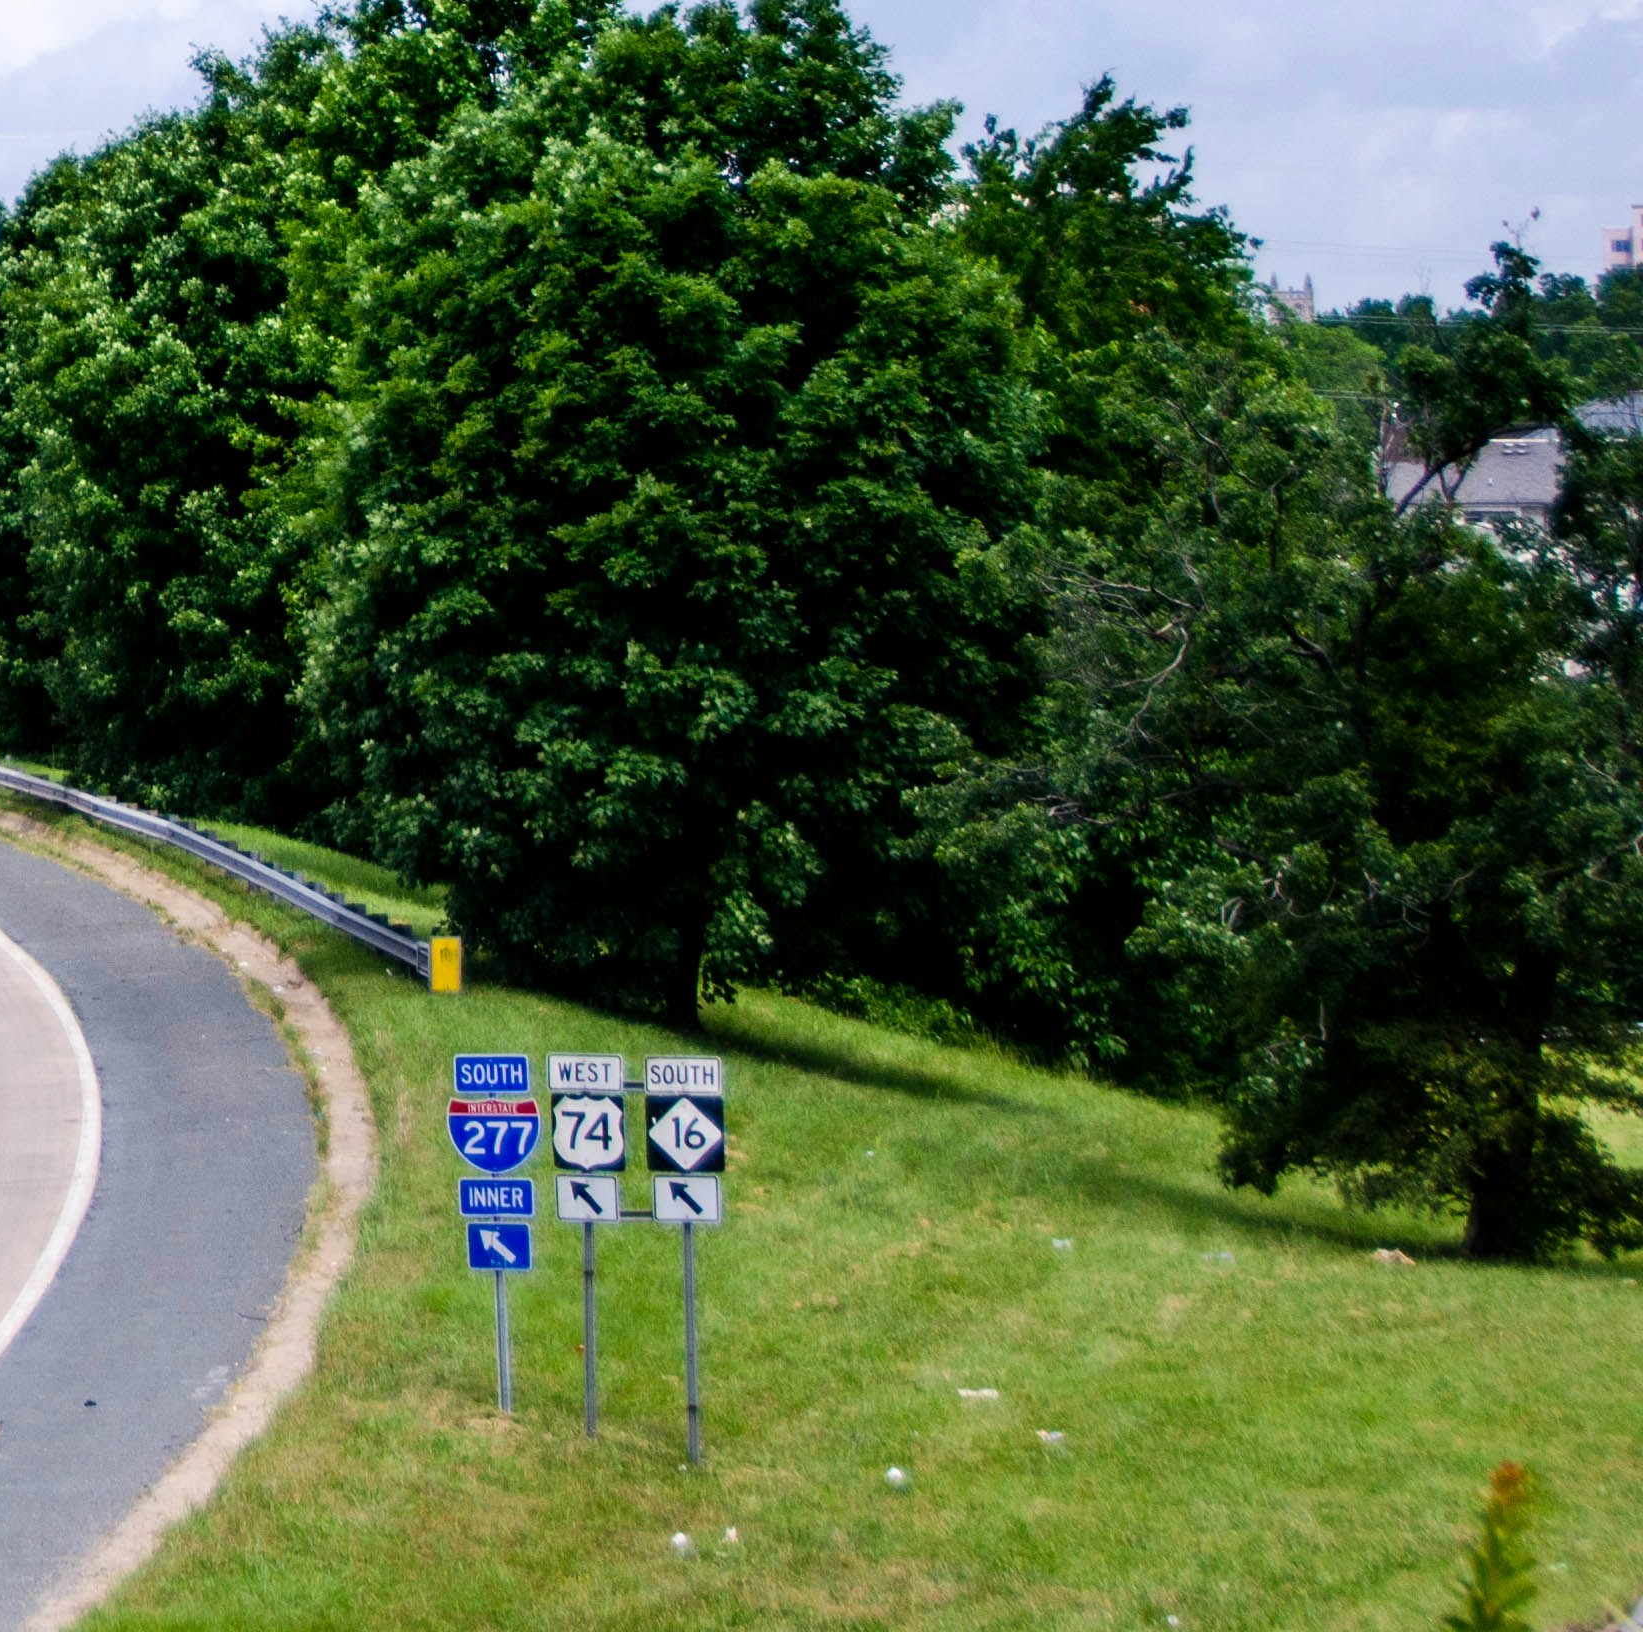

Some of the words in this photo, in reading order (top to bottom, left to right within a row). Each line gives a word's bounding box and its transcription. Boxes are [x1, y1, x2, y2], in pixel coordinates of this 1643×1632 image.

[460, 1063, 523, 1086] SOUTH
[558, 1061, 611, 1084] WEST
[650, 1065, 714, 1086] SOUTH
[467, 1103, 517, 1114] INTERSTATE
[464, 1120, 533, 1155] 277
[561, 1110, 612, 1151] 74
[671, 1116, 706, 1150] 16
[468, 1186, 524, 1209] INNER
